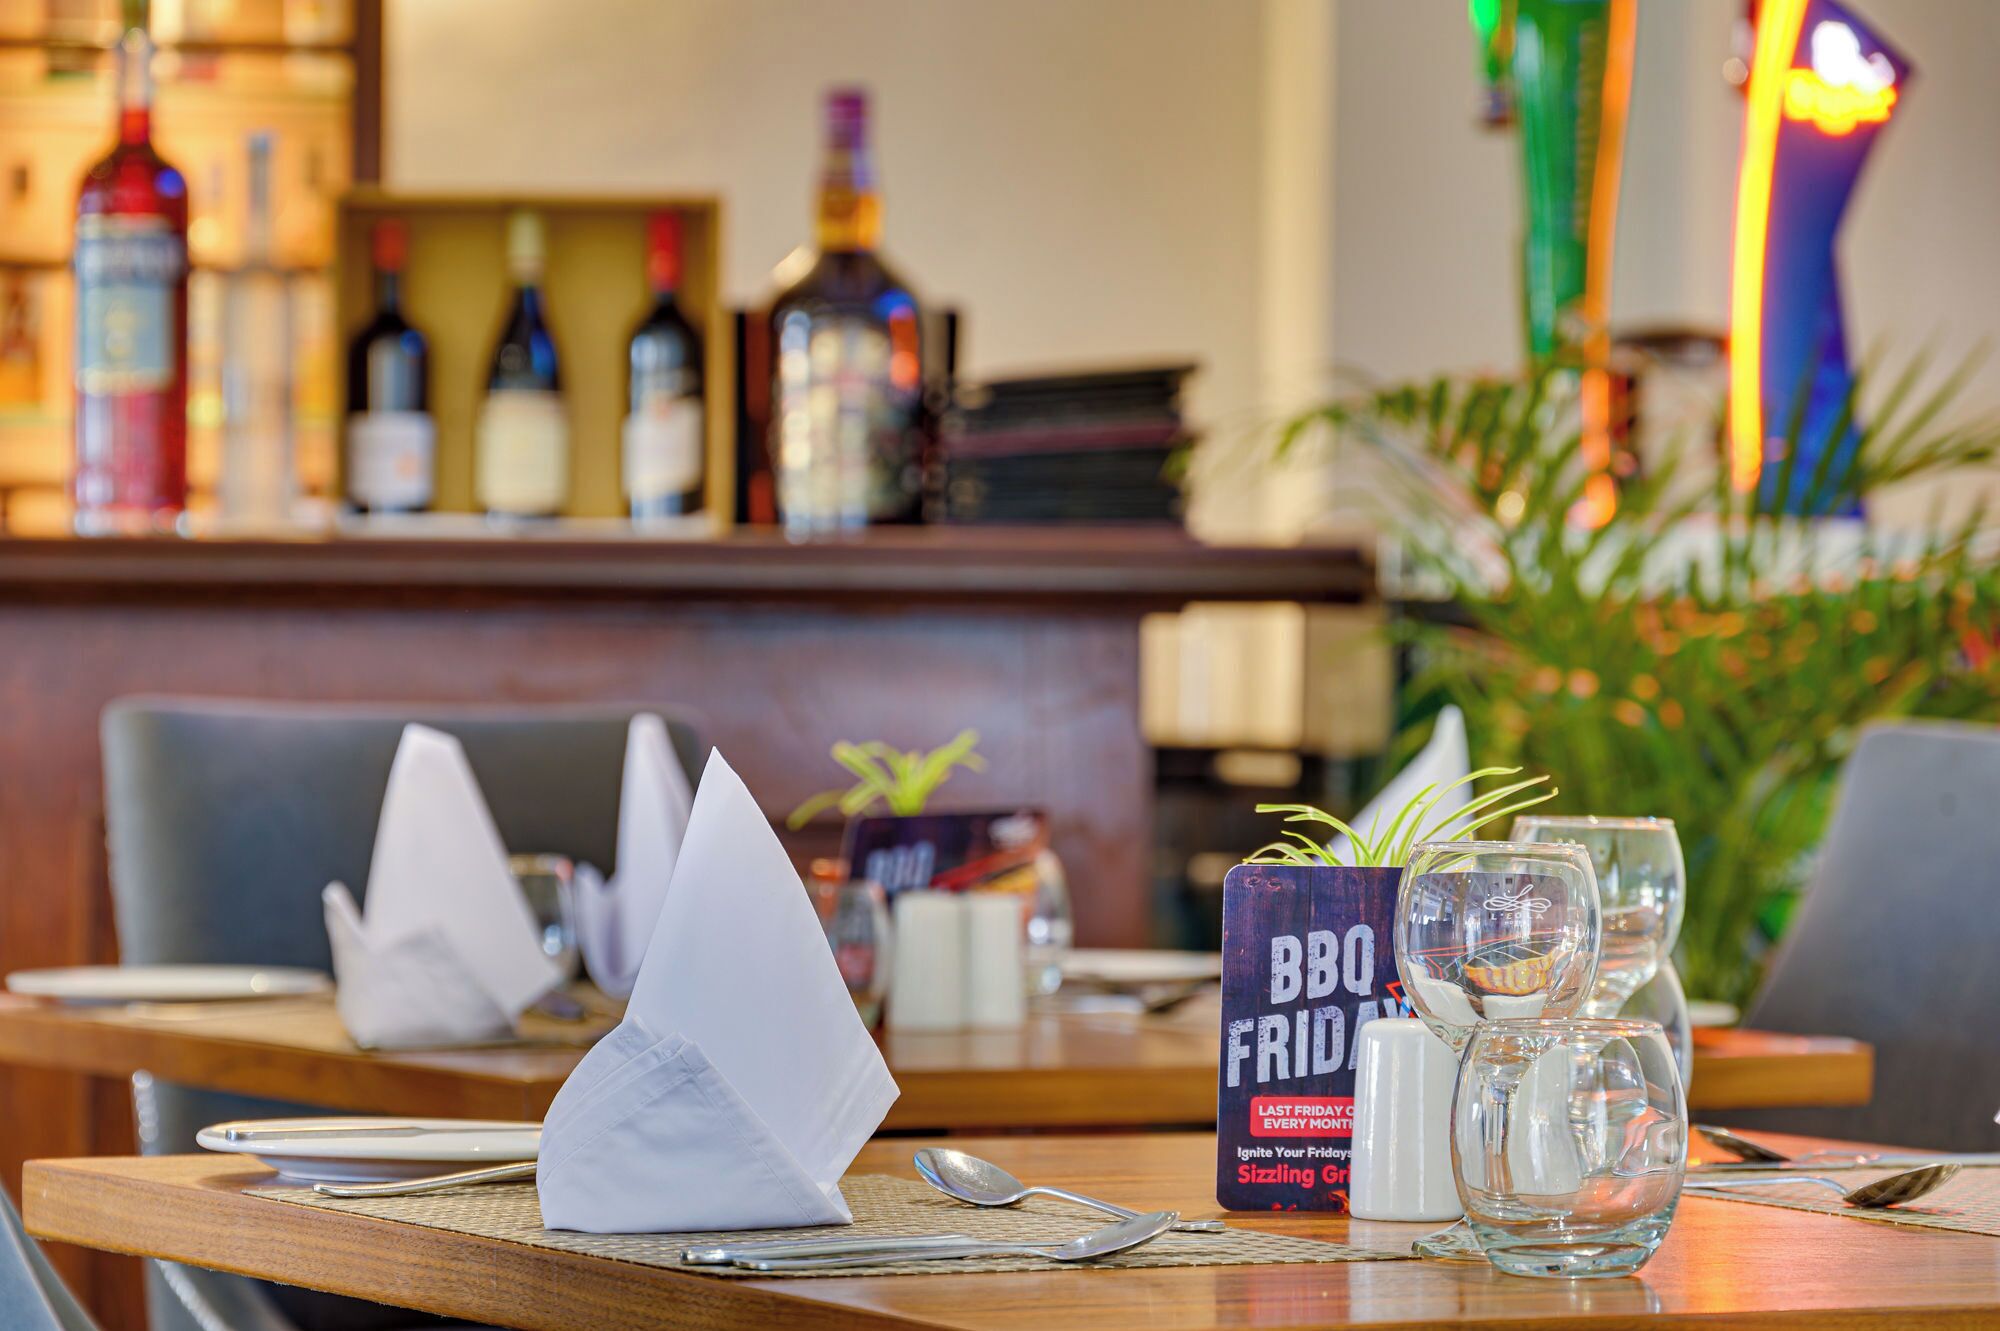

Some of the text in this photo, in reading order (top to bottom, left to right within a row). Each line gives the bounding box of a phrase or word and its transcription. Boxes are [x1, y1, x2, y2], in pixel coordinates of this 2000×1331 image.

[1271, 924, 1375, 1005] BBQ
[1258, 1105, 1292, 1117] LAST
[1294, 1105, 1343, 1117] FRIDAY
[1263, 1118, 1307, 1129] EVERY
[1237, 1146, 1352, 1161] Ignite Your Fridays
[1238, 1164, 1315, 1189] Sizzling
